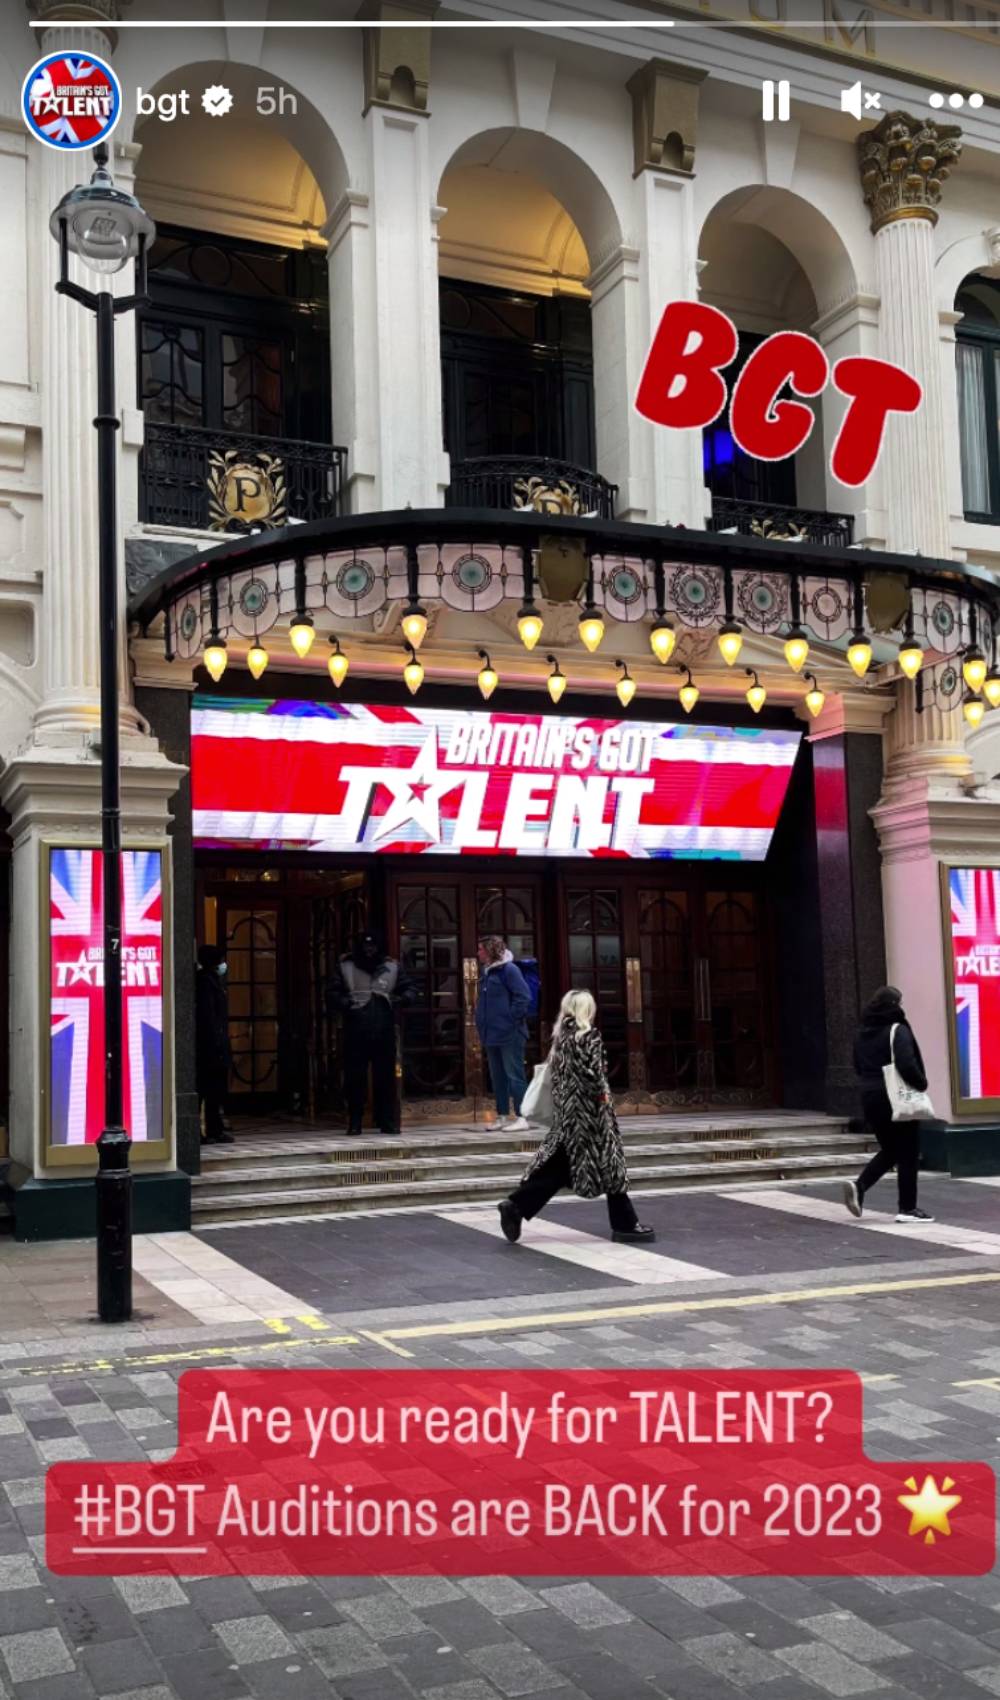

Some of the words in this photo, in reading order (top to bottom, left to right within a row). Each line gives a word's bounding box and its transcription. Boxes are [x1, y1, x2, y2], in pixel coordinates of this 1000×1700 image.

[338, 724, 655, 849] TALENT
[445, 723, 592, 770] BRITAIN'S
[598, 728, 658, 772] GOT
